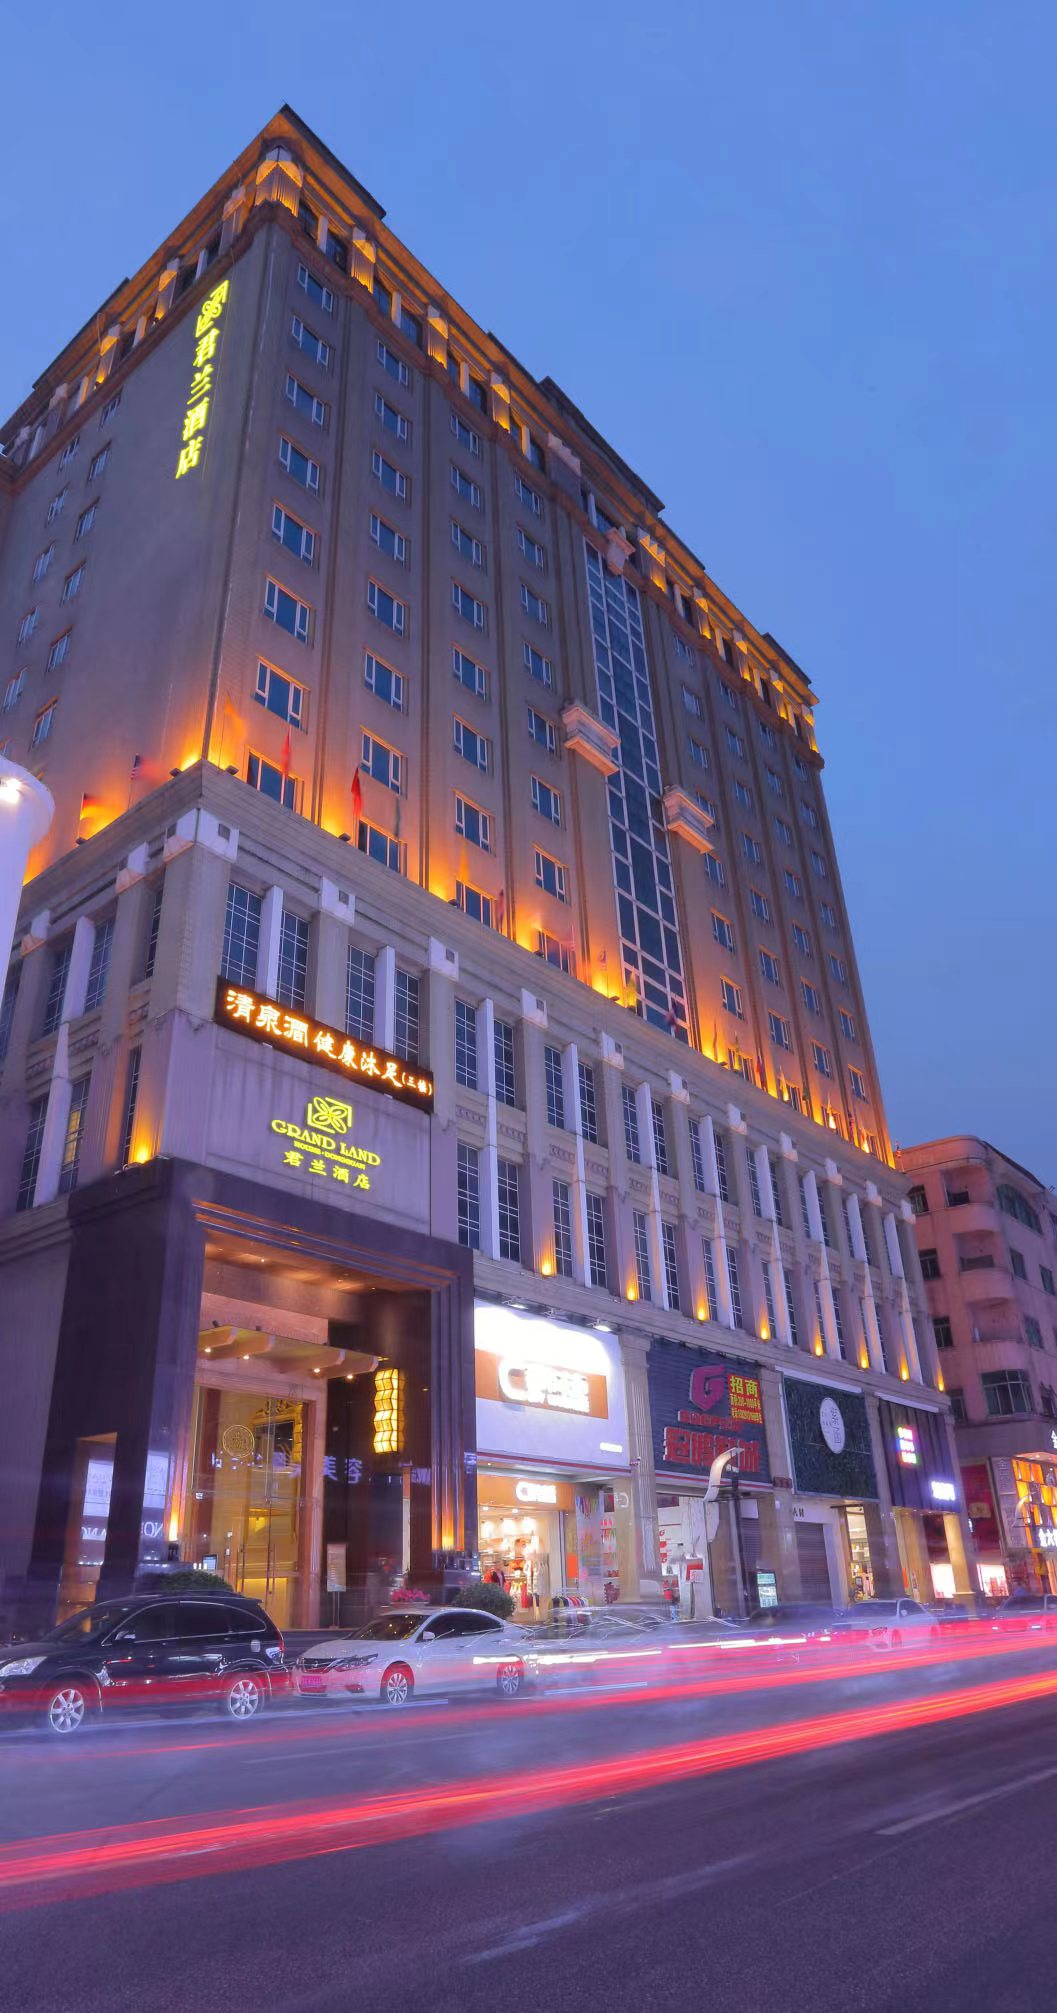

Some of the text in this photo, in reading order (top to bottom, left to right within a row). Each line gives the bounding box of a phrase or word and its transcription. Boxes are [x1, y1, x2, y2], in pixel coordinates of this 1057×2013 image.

[175, 327, 221, 479] 君兰酒店
[270, 1119, 382, 1167] GRAND LAND
[282, 1150, 371, 1191] 君兰酒店
[729, 1375, 759, 1398] 招商
